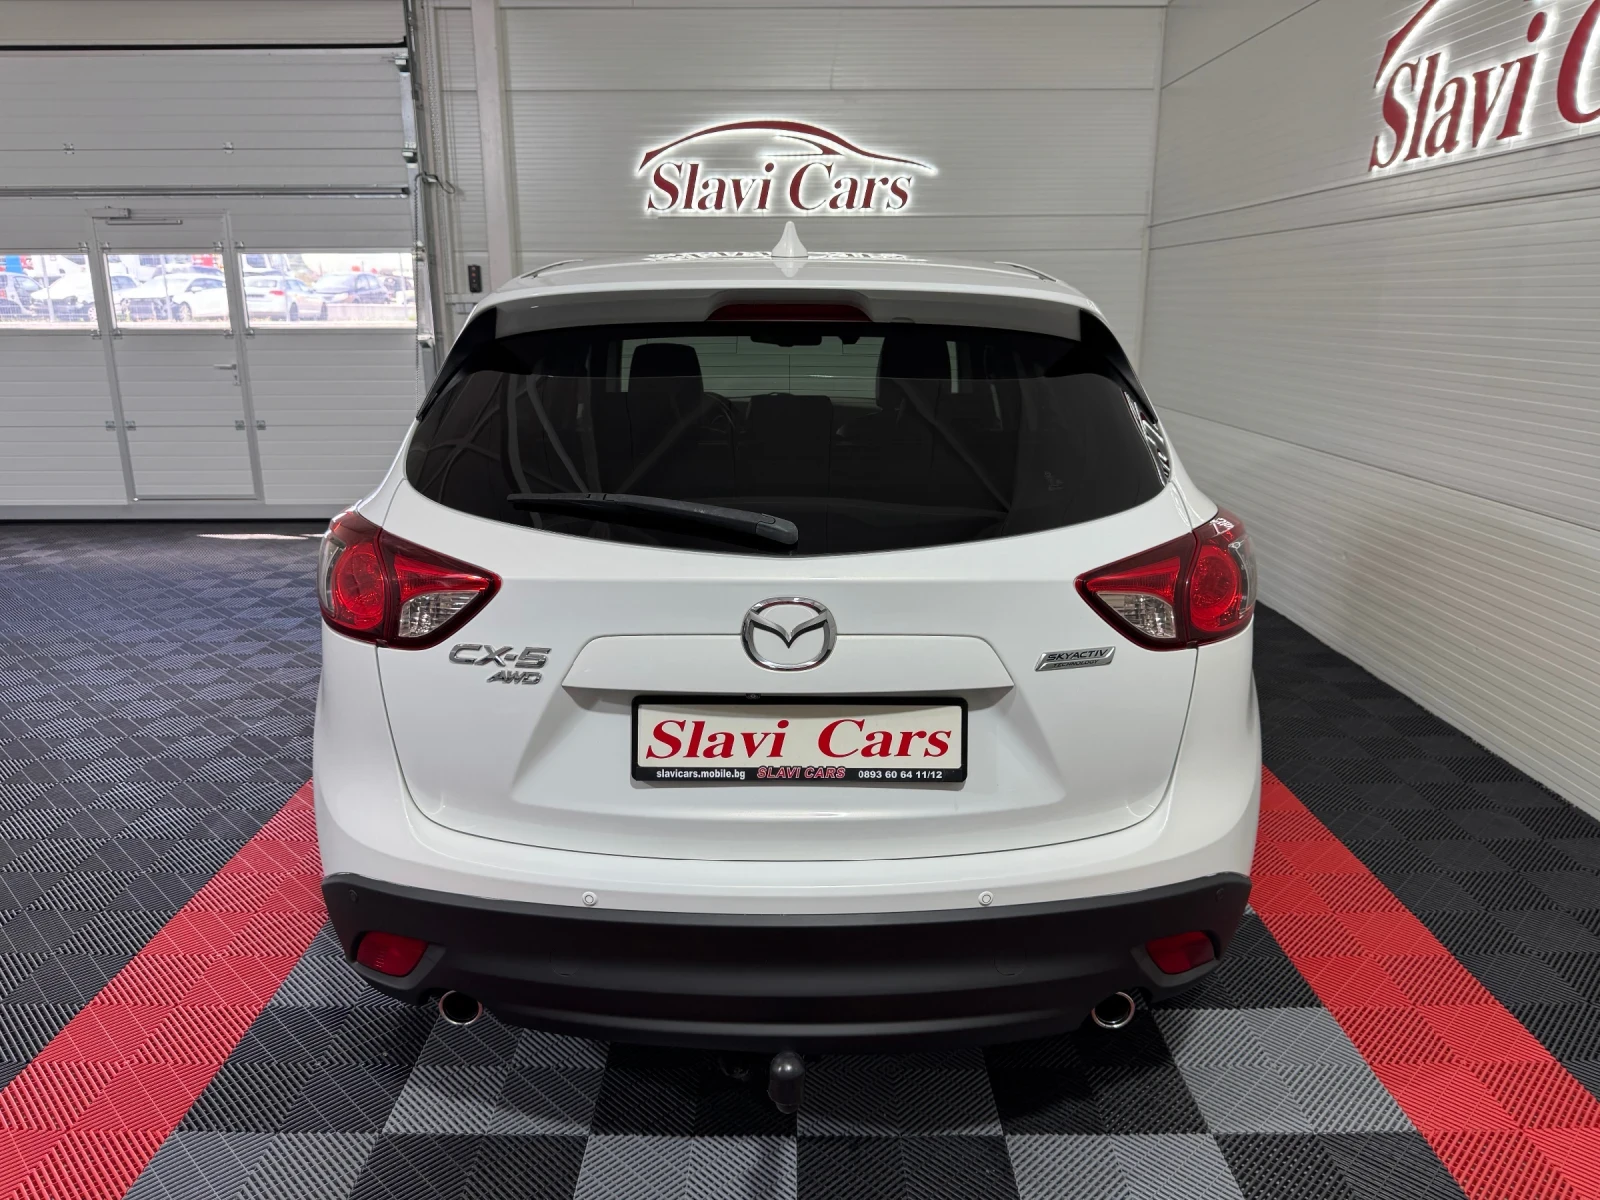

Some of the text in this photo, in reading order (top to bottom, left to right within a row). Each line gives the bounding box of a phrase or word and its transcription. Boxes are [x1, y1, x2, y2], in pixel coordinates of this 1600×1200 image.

[1368, 11, 1548, 173] Slavi
[647, 161, 913, 211] Slavi Cars
[448, 643, 552, 669] CX-5
[1046, 649, 1108, 662] SKYACTIV
[1053, 659, 1099, 668] TECHNOLOGY
[486, 670, 542, 685] AWD
[646, 718, 952, 760] Slavi Cars
[656, 765, 942, 780] slavicars.mobile.bg SLAVI CARS 0893 60 64 11/12
